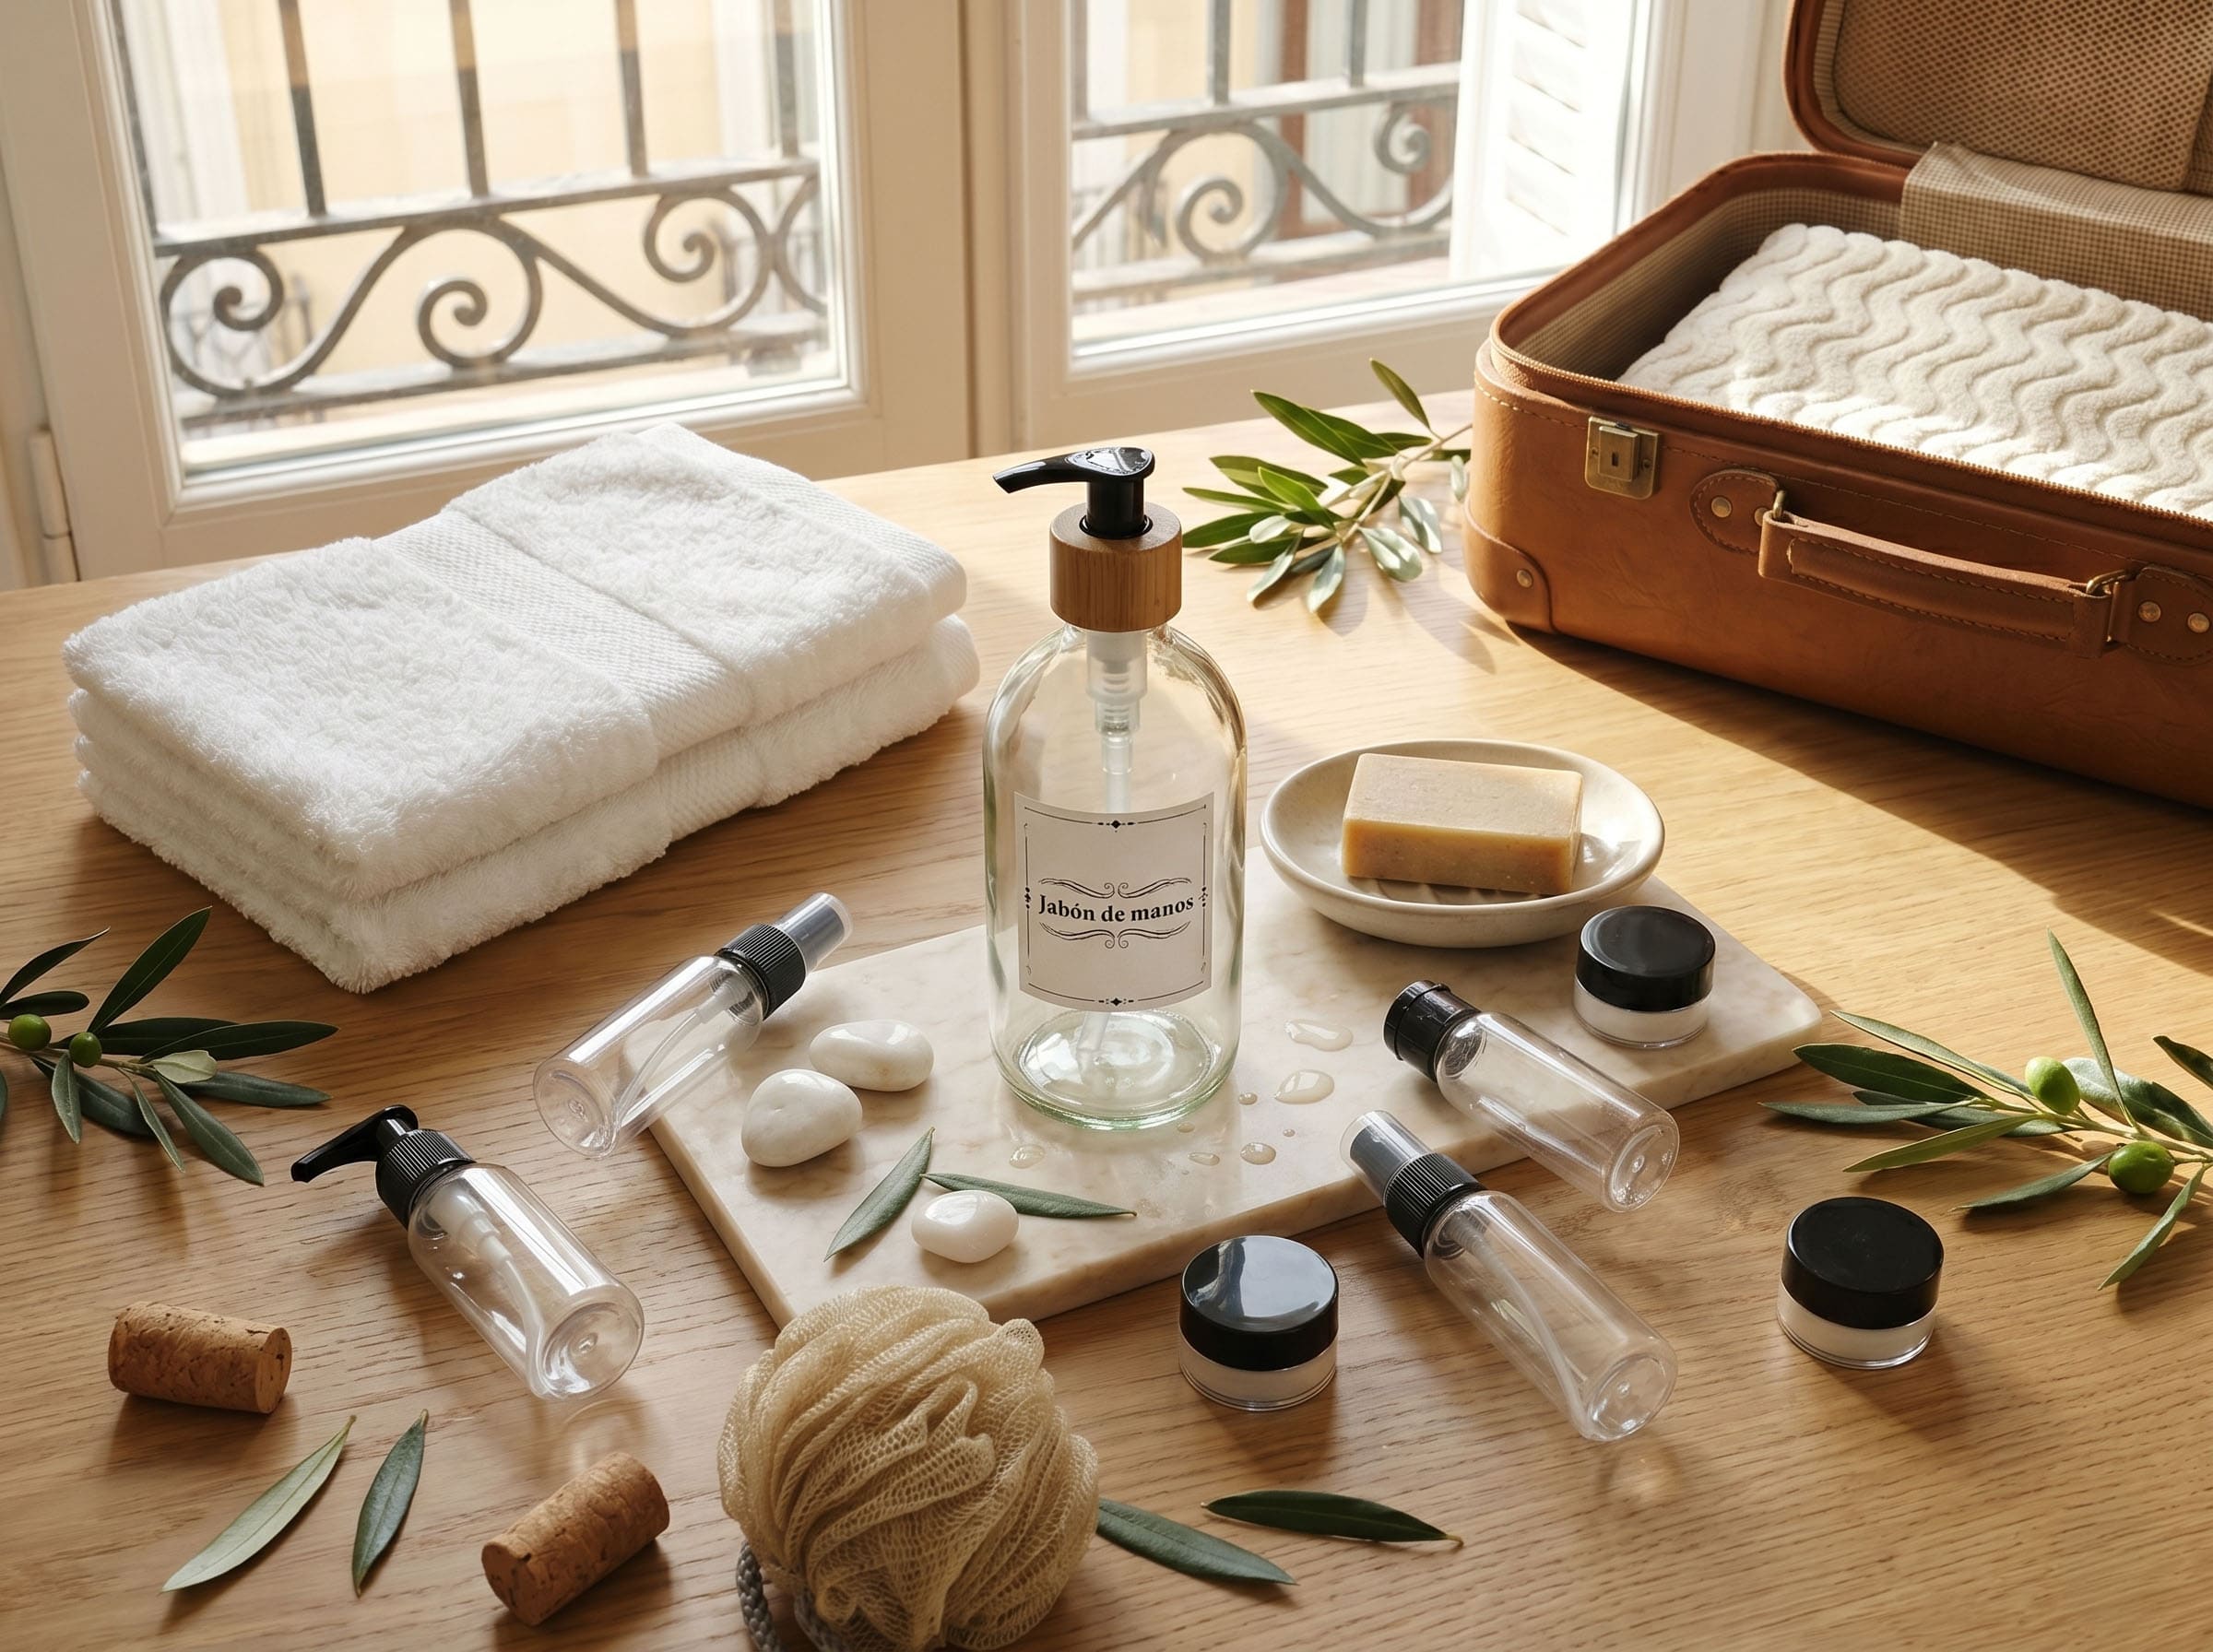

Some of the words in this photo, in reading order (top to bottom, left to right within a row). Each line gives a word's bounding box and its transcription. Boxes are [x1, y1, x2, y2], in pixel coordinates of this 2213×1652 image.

[1038, 894, 1096, 922] Jabón
[1101, 905, 1126, 923] de
[1130, 896, 1194, 922] manos
